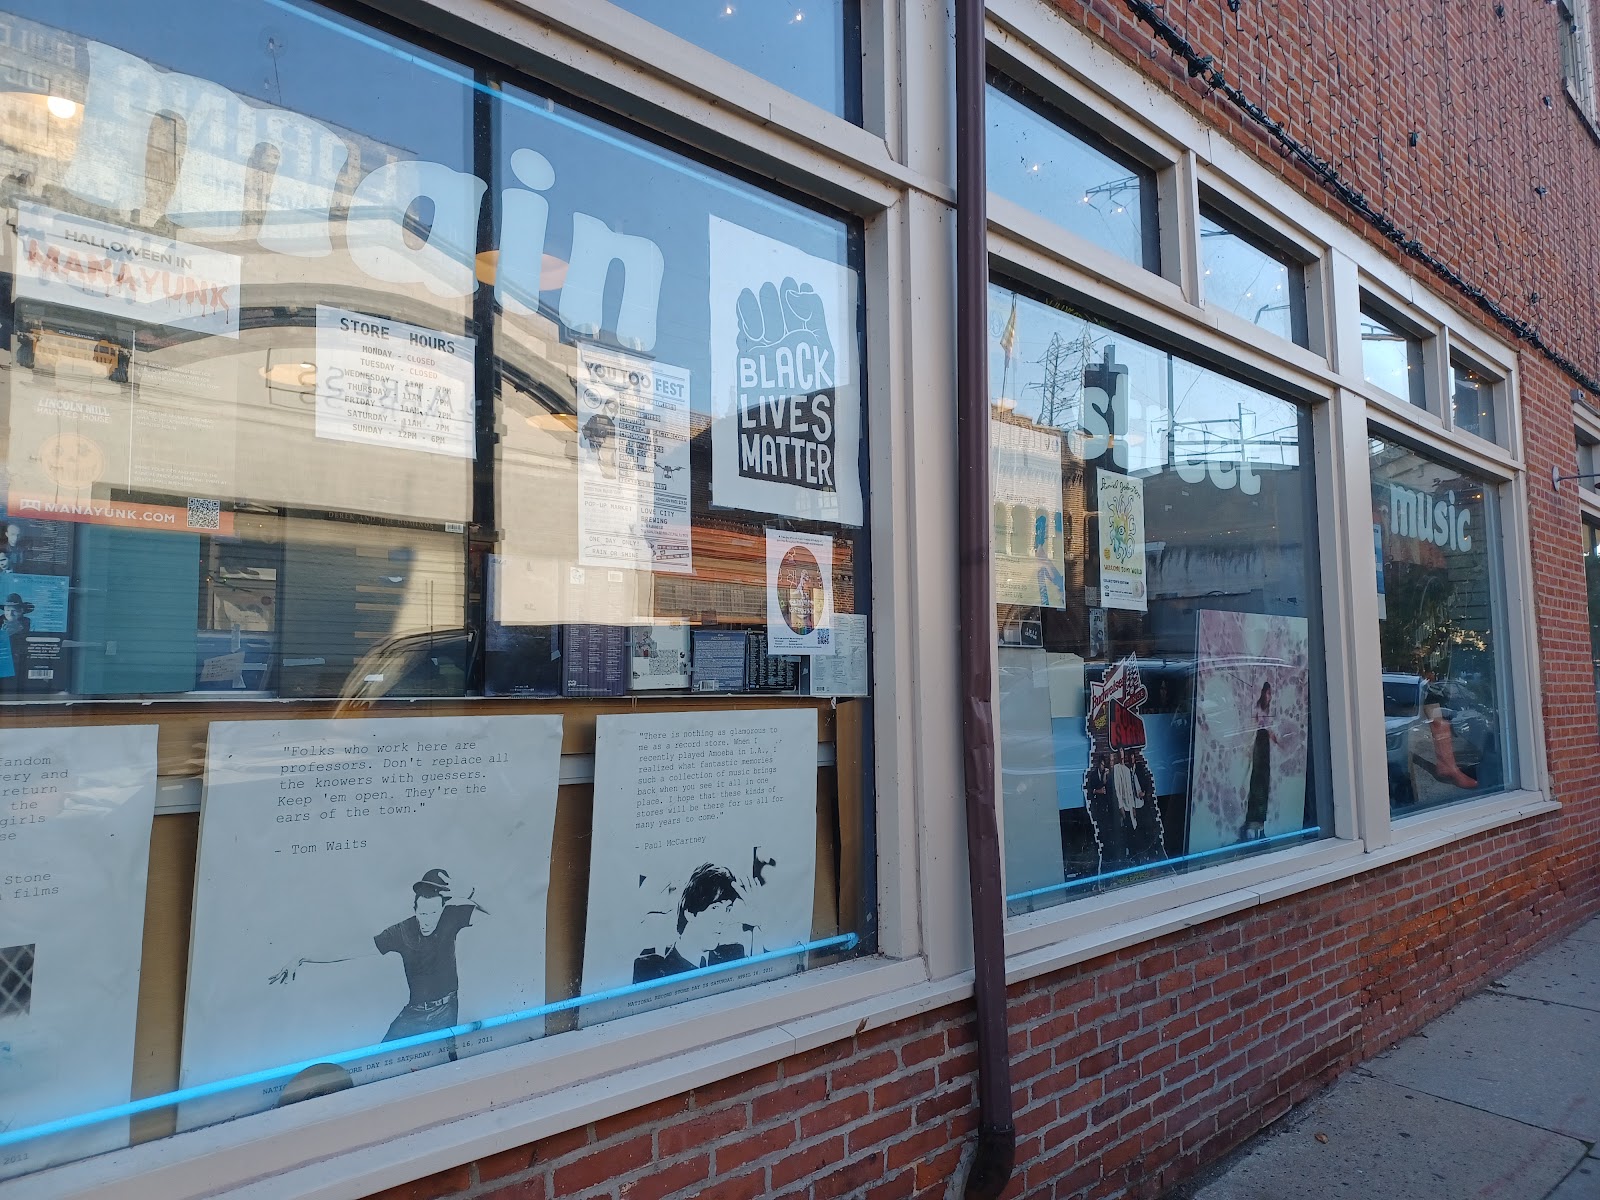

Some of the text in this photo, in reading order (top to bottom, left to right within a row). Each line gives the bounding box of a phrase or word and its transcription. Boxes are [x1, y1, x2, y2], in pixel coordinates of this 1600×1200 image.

[64, 229, 192, 269] HALLOWEEN IN
[28, 239, 229, 313] MANAYUNK
[340, 318, 455, 354] STORE HOURS
[362, 346, 435, 366] MONDAY CLOSED
[360, 358, 438, 379] TUESDAY CLOSED
[740, 341, 833, 390] BLACK
[344, 370, 390, 384] WEDNESDAY
[584, 361, 617, 380] YOU
[656, 377, 684, 398] FEST
[348, 383, 450, 407] THURSDAY 11AM 7PM
[38, 398, 110, 416] LINCOLN MILL
[345, 396, 375, 407] FRIDAY
[400, 405, 420, 416] 11AM
[37, 407, 110, 423] HAUNTED HOUSE
[347, 410, 450, 432] SATURDAY 11AM 7PM
[740, 393, 832, 442] LIVES
[352, 424, 445, 444] SUNDAY 12PM 6PM
[742, 433, 833, 486] MATTER
[45, 502, 175, 523] MANAYUNK.COM
[610, 504, 632, 512] MARKET
[328, 512, 354, 521] DEREK
[641, 515, 668, 524] BREWING
[1390, 484, 1471, 552] music
[730, 728, 766, 736] glamorous
[283, 742, 476, 756] "Folks who work here are
[675, 740, 700, 748] record
[640, 753, 674, 761] recently
[678, 750, 705, 760] played
[709, 749, 733, 757] Amoeba
[280, 753, 509, 775] professors. Don't replace all
[639, 764, 673, 773] realized
[678, 762, 695, 770] what
[700, 759, 737, 768] fantastic
[41, 769, 69, 780] and
[280, 770, 487, 790] the knowers with guessers.
[638, 776, 656, 784] such
[669, 772, 712, 781] collection
[729, 768, 750, 776] music
[2, 786, 58, 796] return
[277, 784, 487, 808] Keep 'em open. They're the
[637, 787, 655, 795] back
[683, 784, 695, 792] you
[637, 798, 663, 808] place.
[678, 795, 694, 803] hope
[720, 789, 741, 798] these
[745, 787, 765, 795] kinds
[11, 801, 38, 810] the
[276, 802, 426, 824] ears of the town."
[637, 810, 663, 818] stores
[668, 805, 686, 813] will
[704, 802, 724, 810] there
[0, 815, 46, 828] girls
[659, 818, 680, 828] years
[698, 812, 724, 821] come."
[291, 840, 367, 855] Tom Waits
[645, 836, 706, 850] Paul McCartney
[5, 873, 51, 885] Stone
[14, 886, 59, 899] films
[627, 997, 652, 1008] NATIONAL
[366, 1062, 380, 1070] DAY
[478, 1036, 493, 1044] 2011
[3, 1153, 28, 1165] 2011
